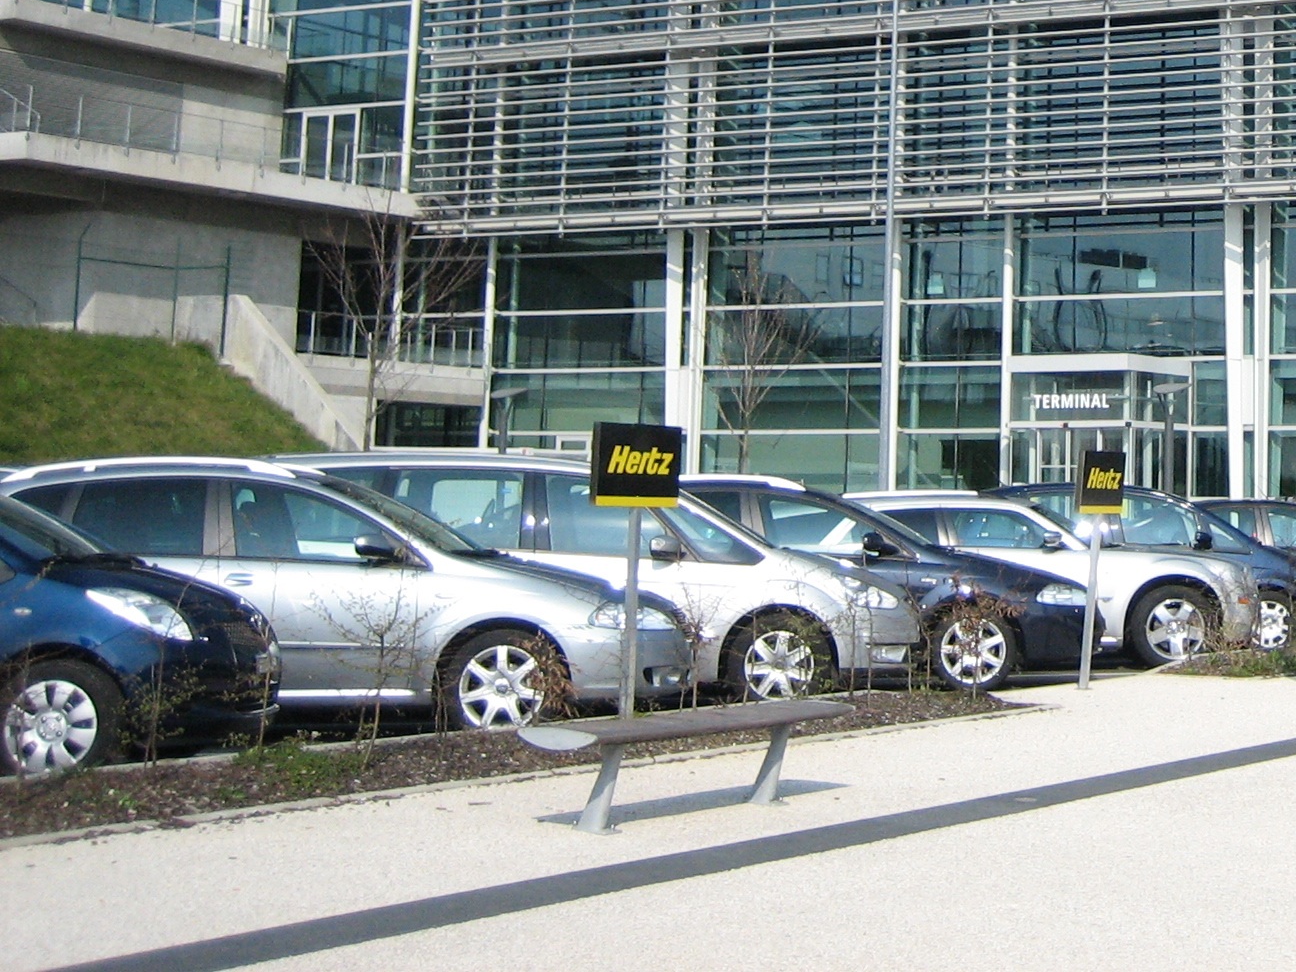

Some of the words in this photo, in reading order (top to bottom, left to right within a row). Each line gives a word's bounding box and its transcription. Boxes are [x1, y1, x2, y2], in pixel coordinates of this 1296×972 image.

[1033, 393, 1110, 409] TERMINAL
[607, 445, 674, 475] Hertz
[1087, 467, 1122, 490] Hertz
